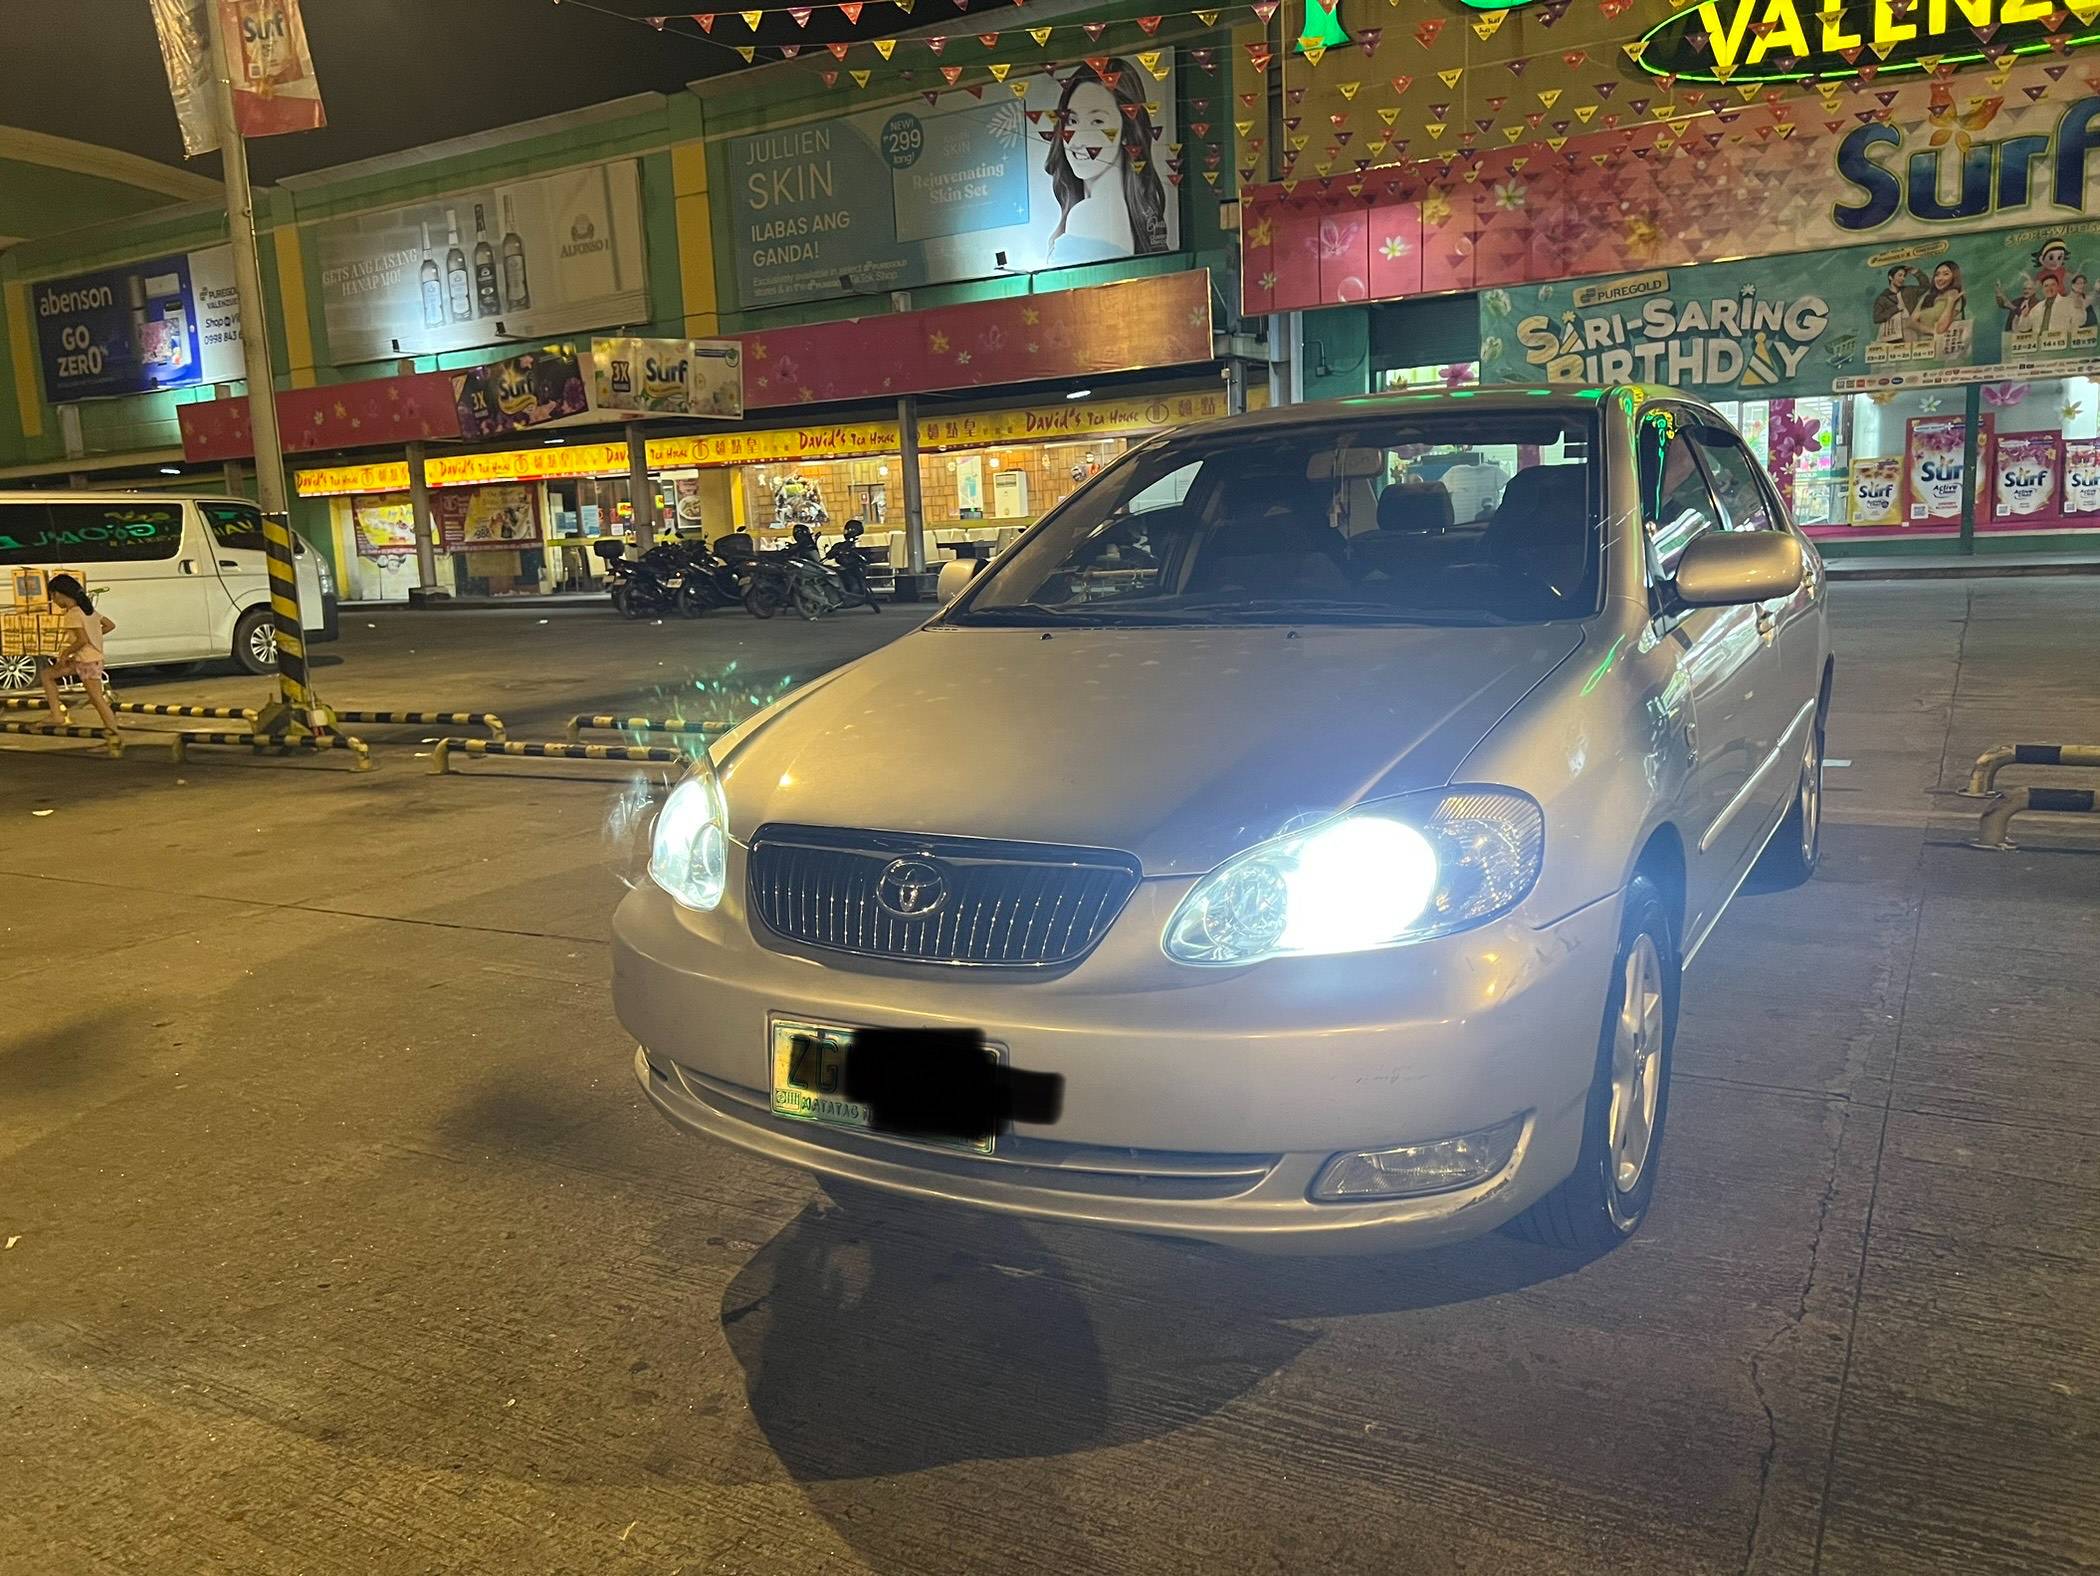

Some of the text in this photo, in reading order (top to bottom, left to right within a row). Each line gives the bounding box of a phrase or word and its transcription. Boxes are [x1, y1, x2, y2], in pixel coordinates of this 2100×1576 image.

[890, 119, 914, 131] NEW!
[746, 128, 830, 165] JULLIEN
[912, 163, 1004, 189] Rejuvenating
[1833, 96, 2100, 232] Surf
[748, 160, 833, 209] SKIN
[929, 183, 988, 204] Skin Set
[752, 211, 850, 242] ILABAS ANG
[753, 241, 819, 267] GANDA!
[322, 267, 350, 285] GETS
[350, 261, 374, 279] ANG
[341, 269, 402, 297] HANAP MO!
[39, 286, 113, 317] abenson
[1598, 278, 1663, 301] PUREGOLD
[205, 317, 223, 328] Shop
[1516, 288, 1831, 365] SARI-SARING
[62, 325, 90, 350] GO
[204, 333, 222, 345] 0998
[611, 361, 630, 383] 3X
[646, 357, 688, 383] Surf
[1547, 333, 1810, 388] BIRTHDAY
[472, 390, 487, 411] 3X
[1025, 408, 1081, 432] David's
[1087, 413, 1104, 426] Tea
[1109, 409, 1139, 424] House
[799, 428, 845, 449] David's
[851, 434, 866, 444] Tea
[870, 431, 895, 443] House
[296, 473, 327, 487] David's
[439, 461, 474, 478] David's
[1921, 460, 1964, 482] Sur
[2004, 470, 2048, 488] Surf
[2071, 470, 2100, 488] Sur
[1858, 483, 1893, 498] Surf
[787, 1033, 846, 1093] ZG
